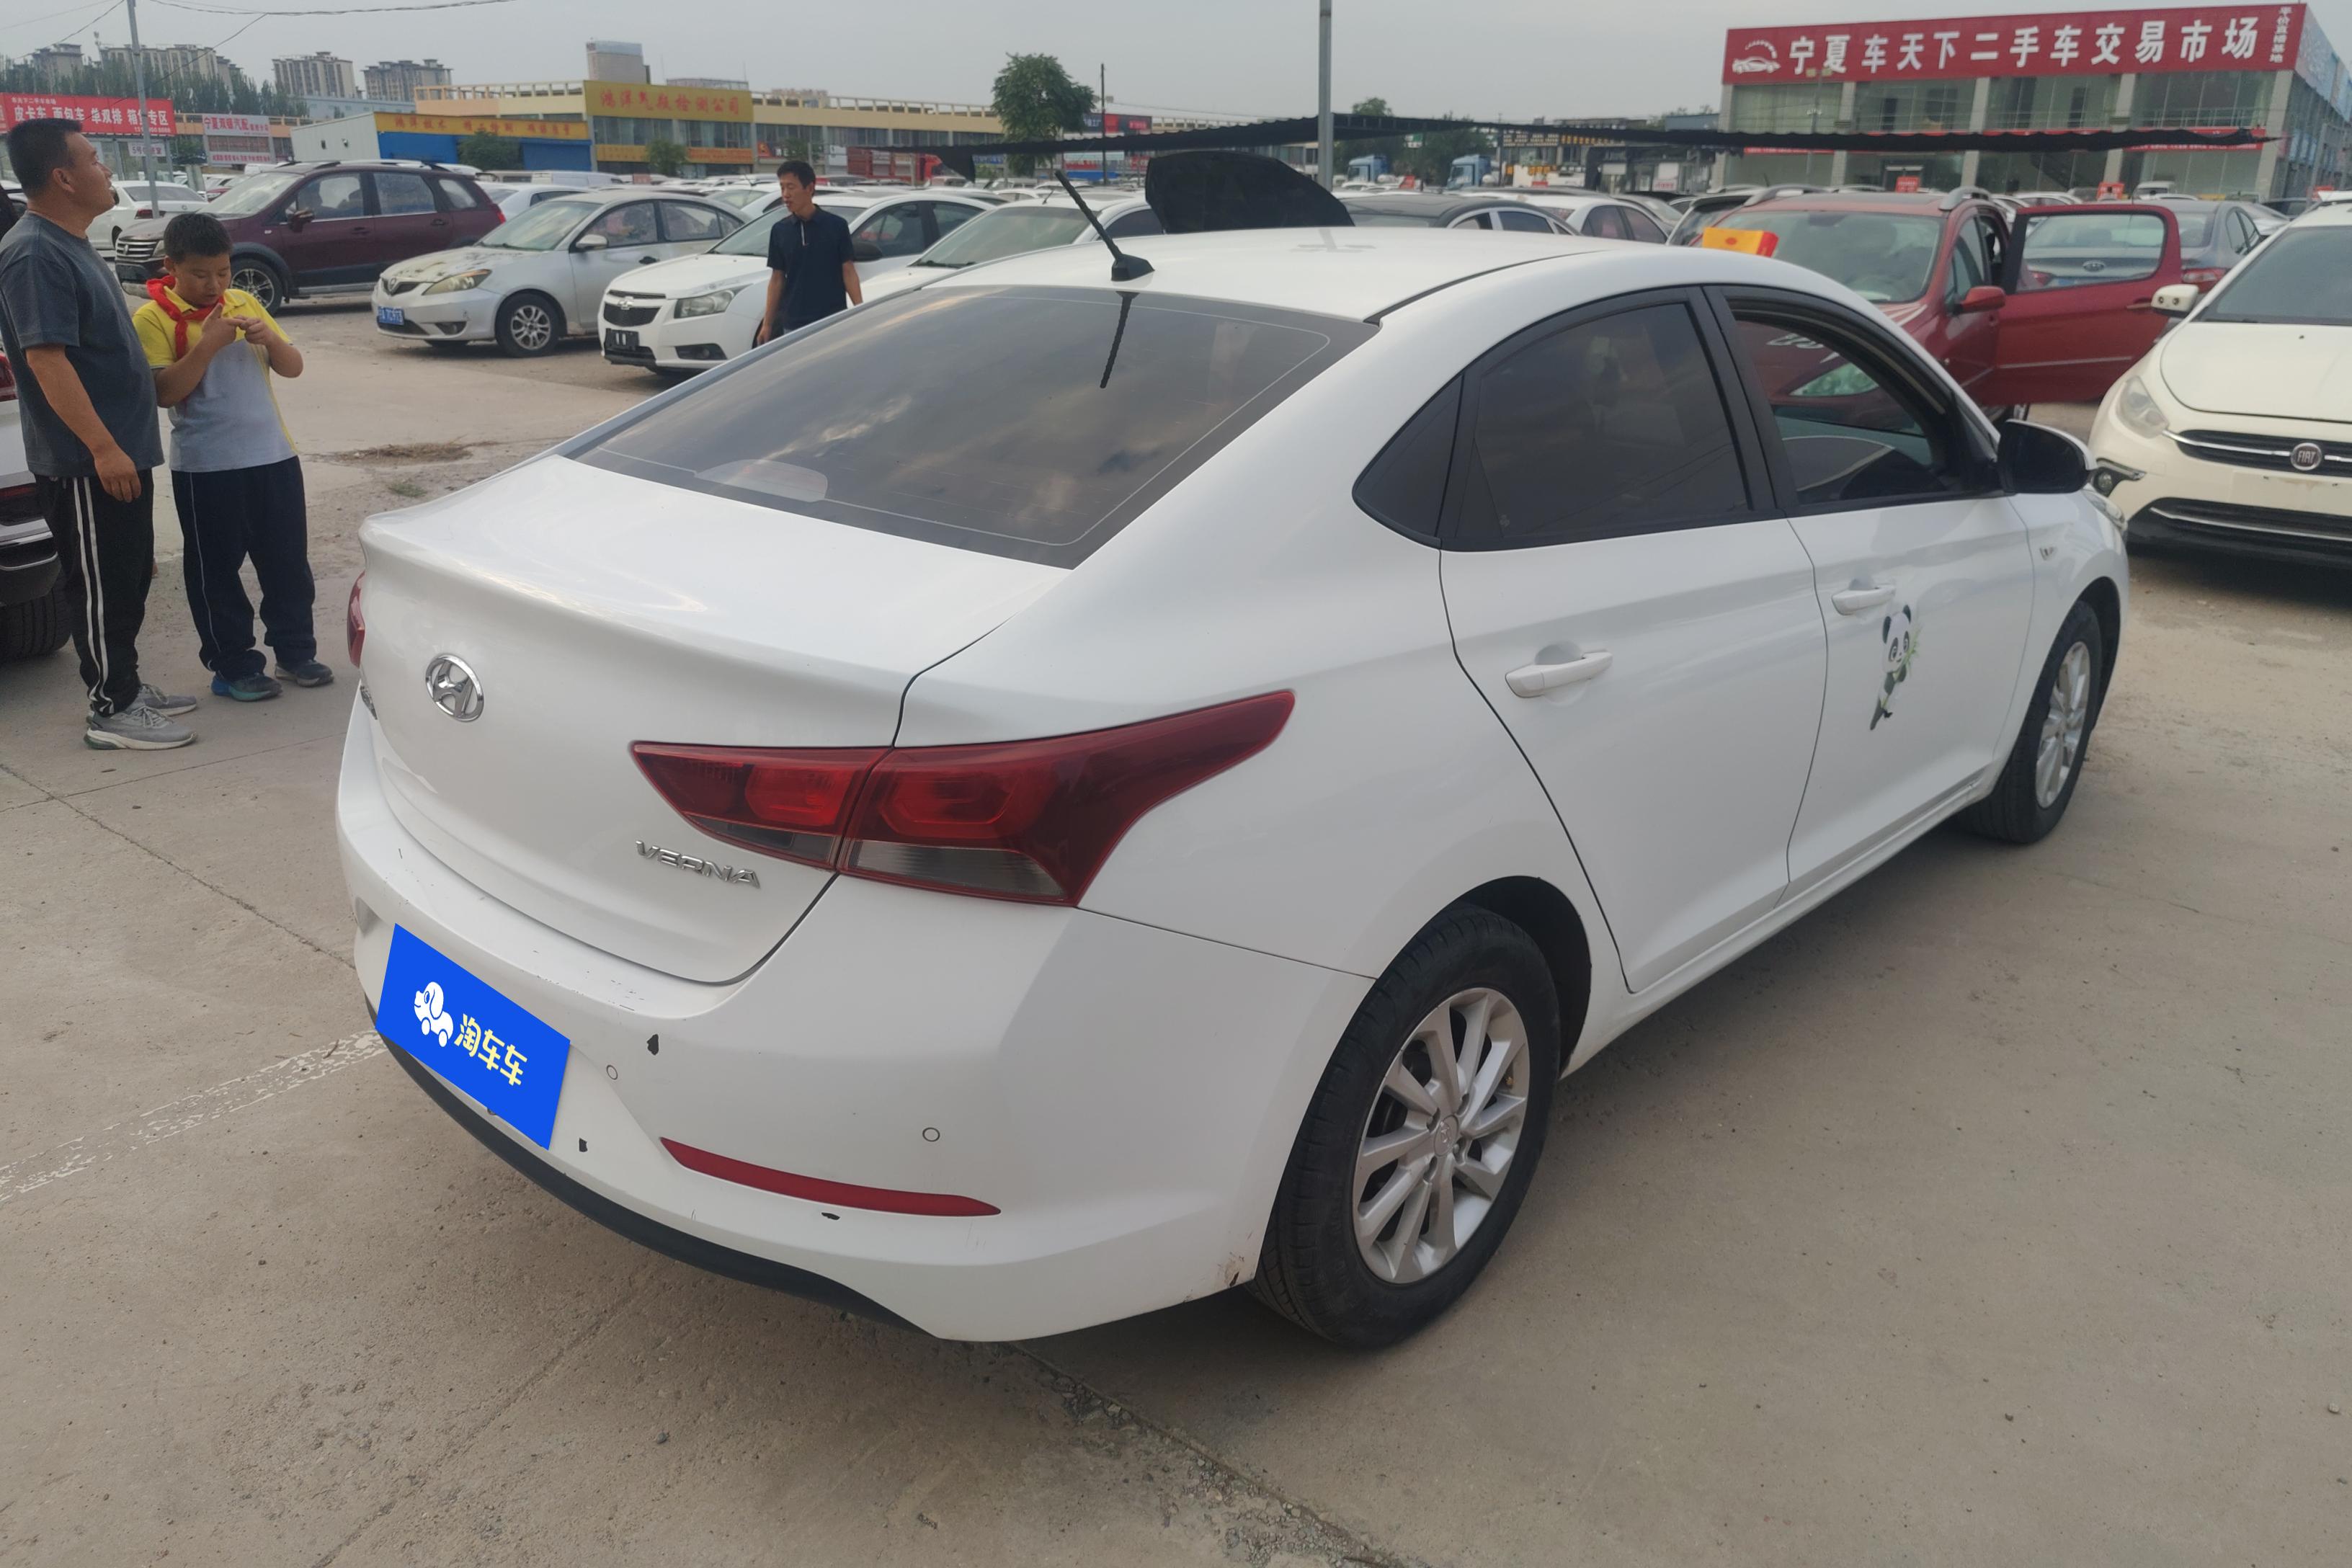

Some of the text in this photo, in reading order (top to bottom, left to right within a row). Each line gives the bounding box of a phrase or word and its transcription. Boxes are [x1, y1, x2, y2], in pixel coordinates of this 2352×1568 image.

[1789, 17, 2258, 75] 宁夏车天下二手车交易市场
[2297, 450, 2317, 464] FIAT
[636, 840, 760, 889] VERNA
